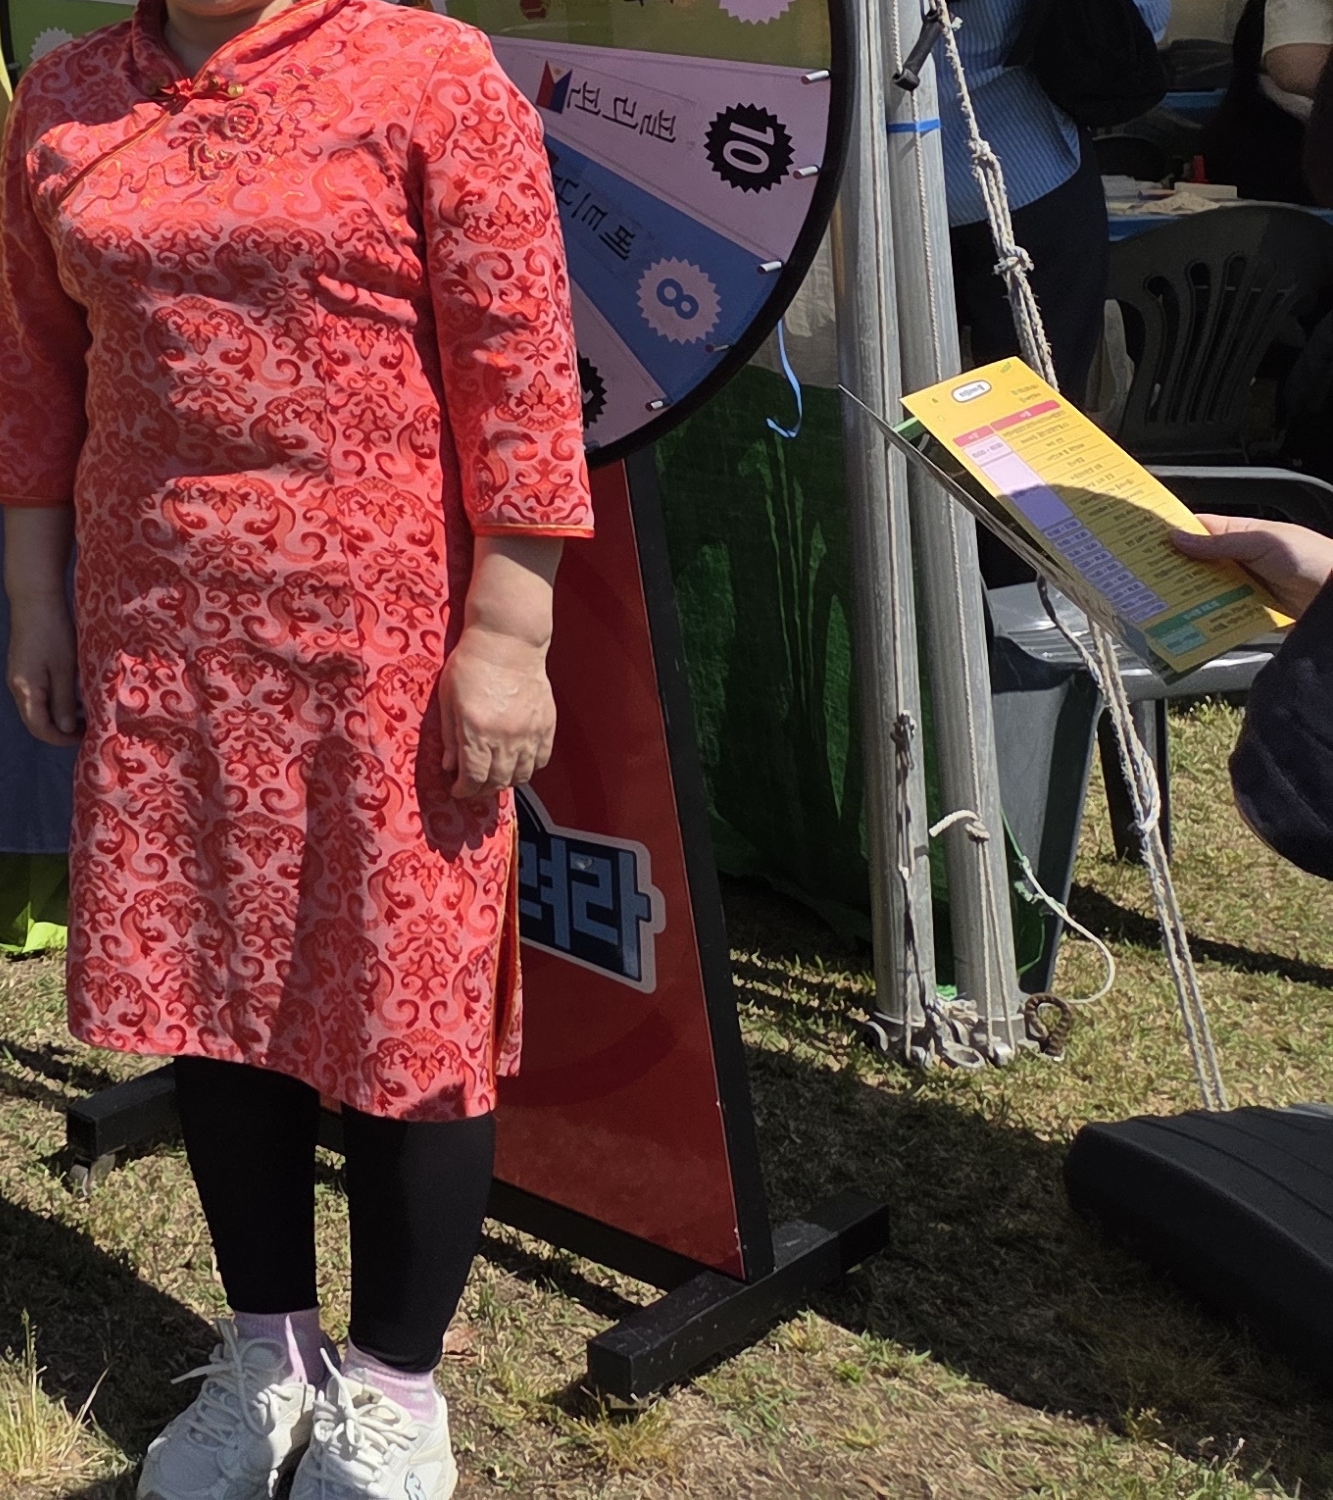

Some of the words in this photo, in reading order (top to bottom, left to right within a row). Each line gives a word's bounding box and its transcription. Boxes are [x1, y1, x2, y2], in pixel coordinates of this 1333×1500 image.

[565, 80, 677, 145] 필리핀
[721, 120, 777, 176] 10
[655, 277, 700, 321] 8
